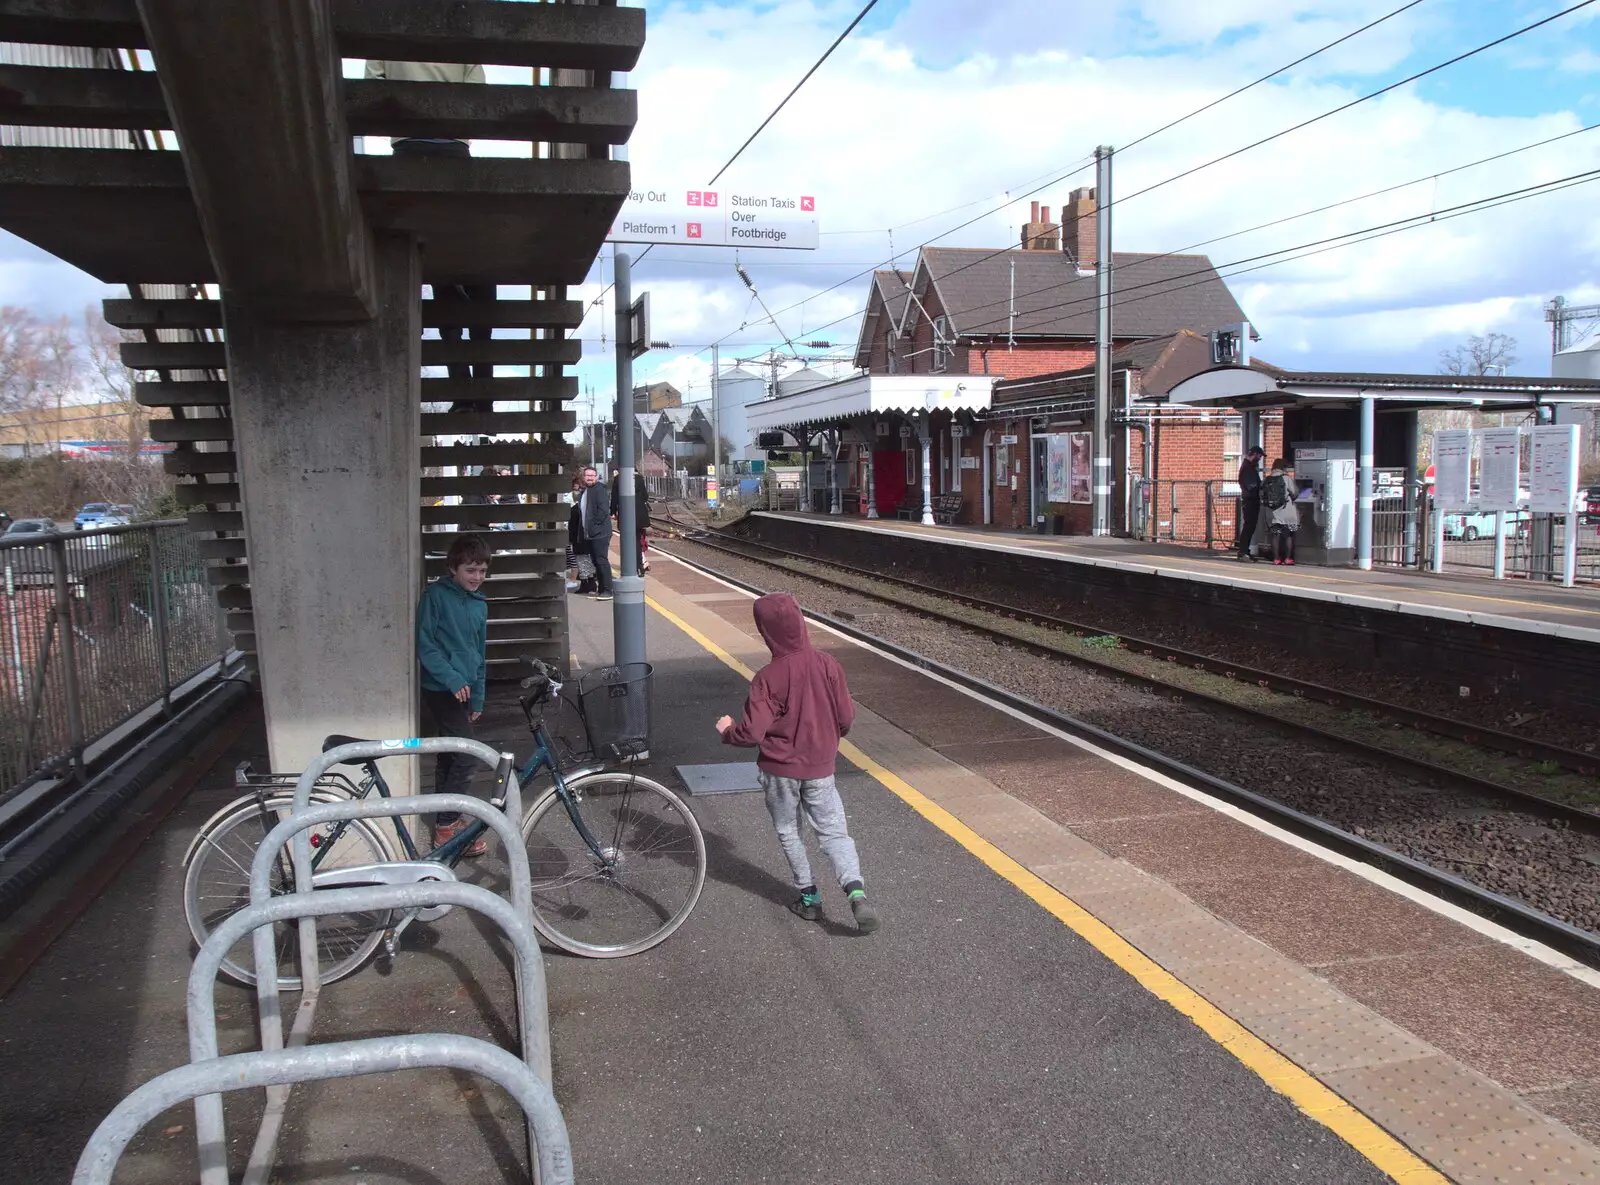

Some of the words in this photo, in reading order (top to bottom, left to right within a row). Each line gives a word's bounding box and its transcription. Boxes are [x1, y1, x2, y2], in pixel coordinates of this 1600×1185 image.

[647, 190, 666, 202] Out
[731, 195, 768, 207] Station
[770, 196, 796, 208] Taxis
[731, 211, 756, 222] Over
[623, 222, 668, 234] Platform
[671, 224, 676, 235] 1
[731, 226, 786, 241] Footbridge
